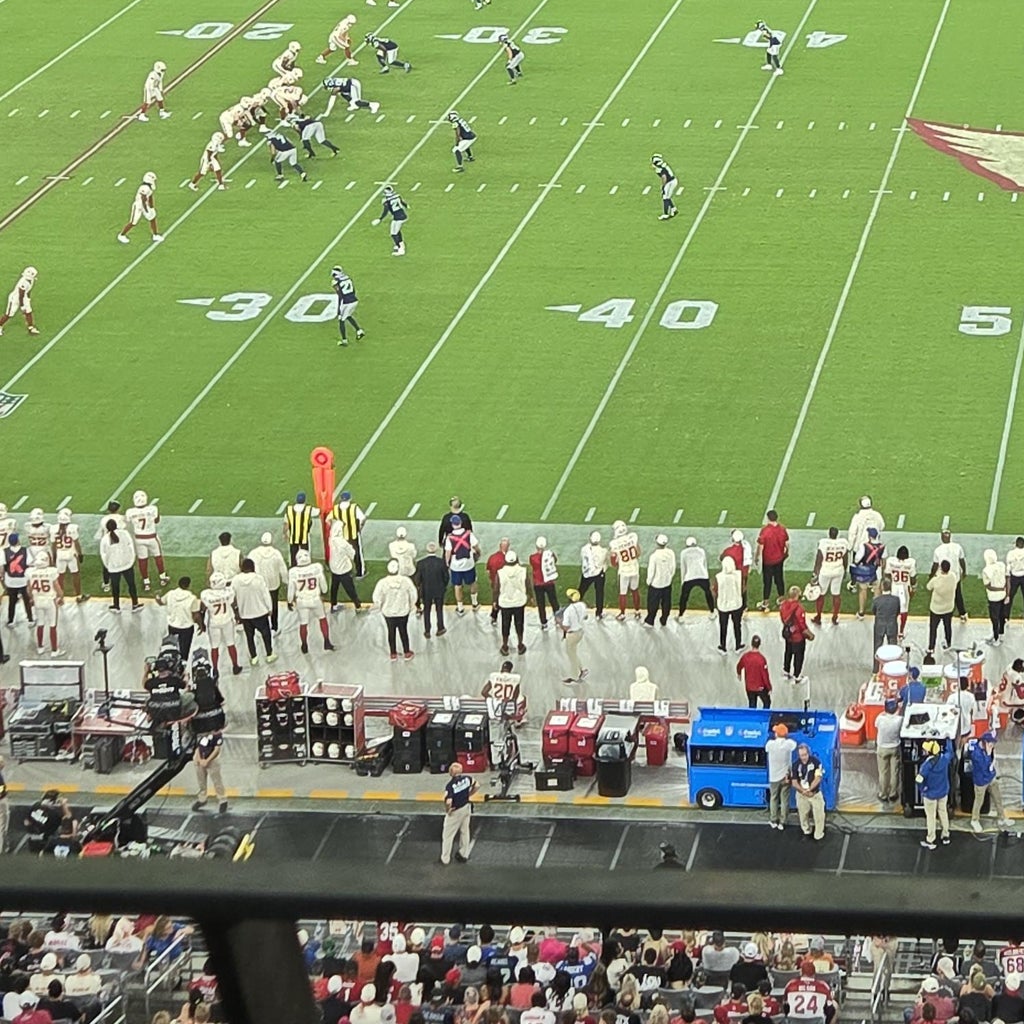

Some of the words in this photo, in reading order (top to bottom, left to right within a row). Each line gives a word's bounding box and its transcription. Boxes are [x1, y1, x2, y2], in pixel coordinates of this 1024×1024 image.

[138, 518, 146, 530] 7
[619, 545, 638, 563] 80
[891, 570, 909, 583] 36
[32, 579, 51, 593] 46
[297, 578, 317, 591] 78
[213, 603, 227, 615] 71
[494, 683, 513, 700] 20
[379, 921, 399, 942] 35
[1006, 957, 1024, 973] 68
[794, 995, 818, 1015] 24
